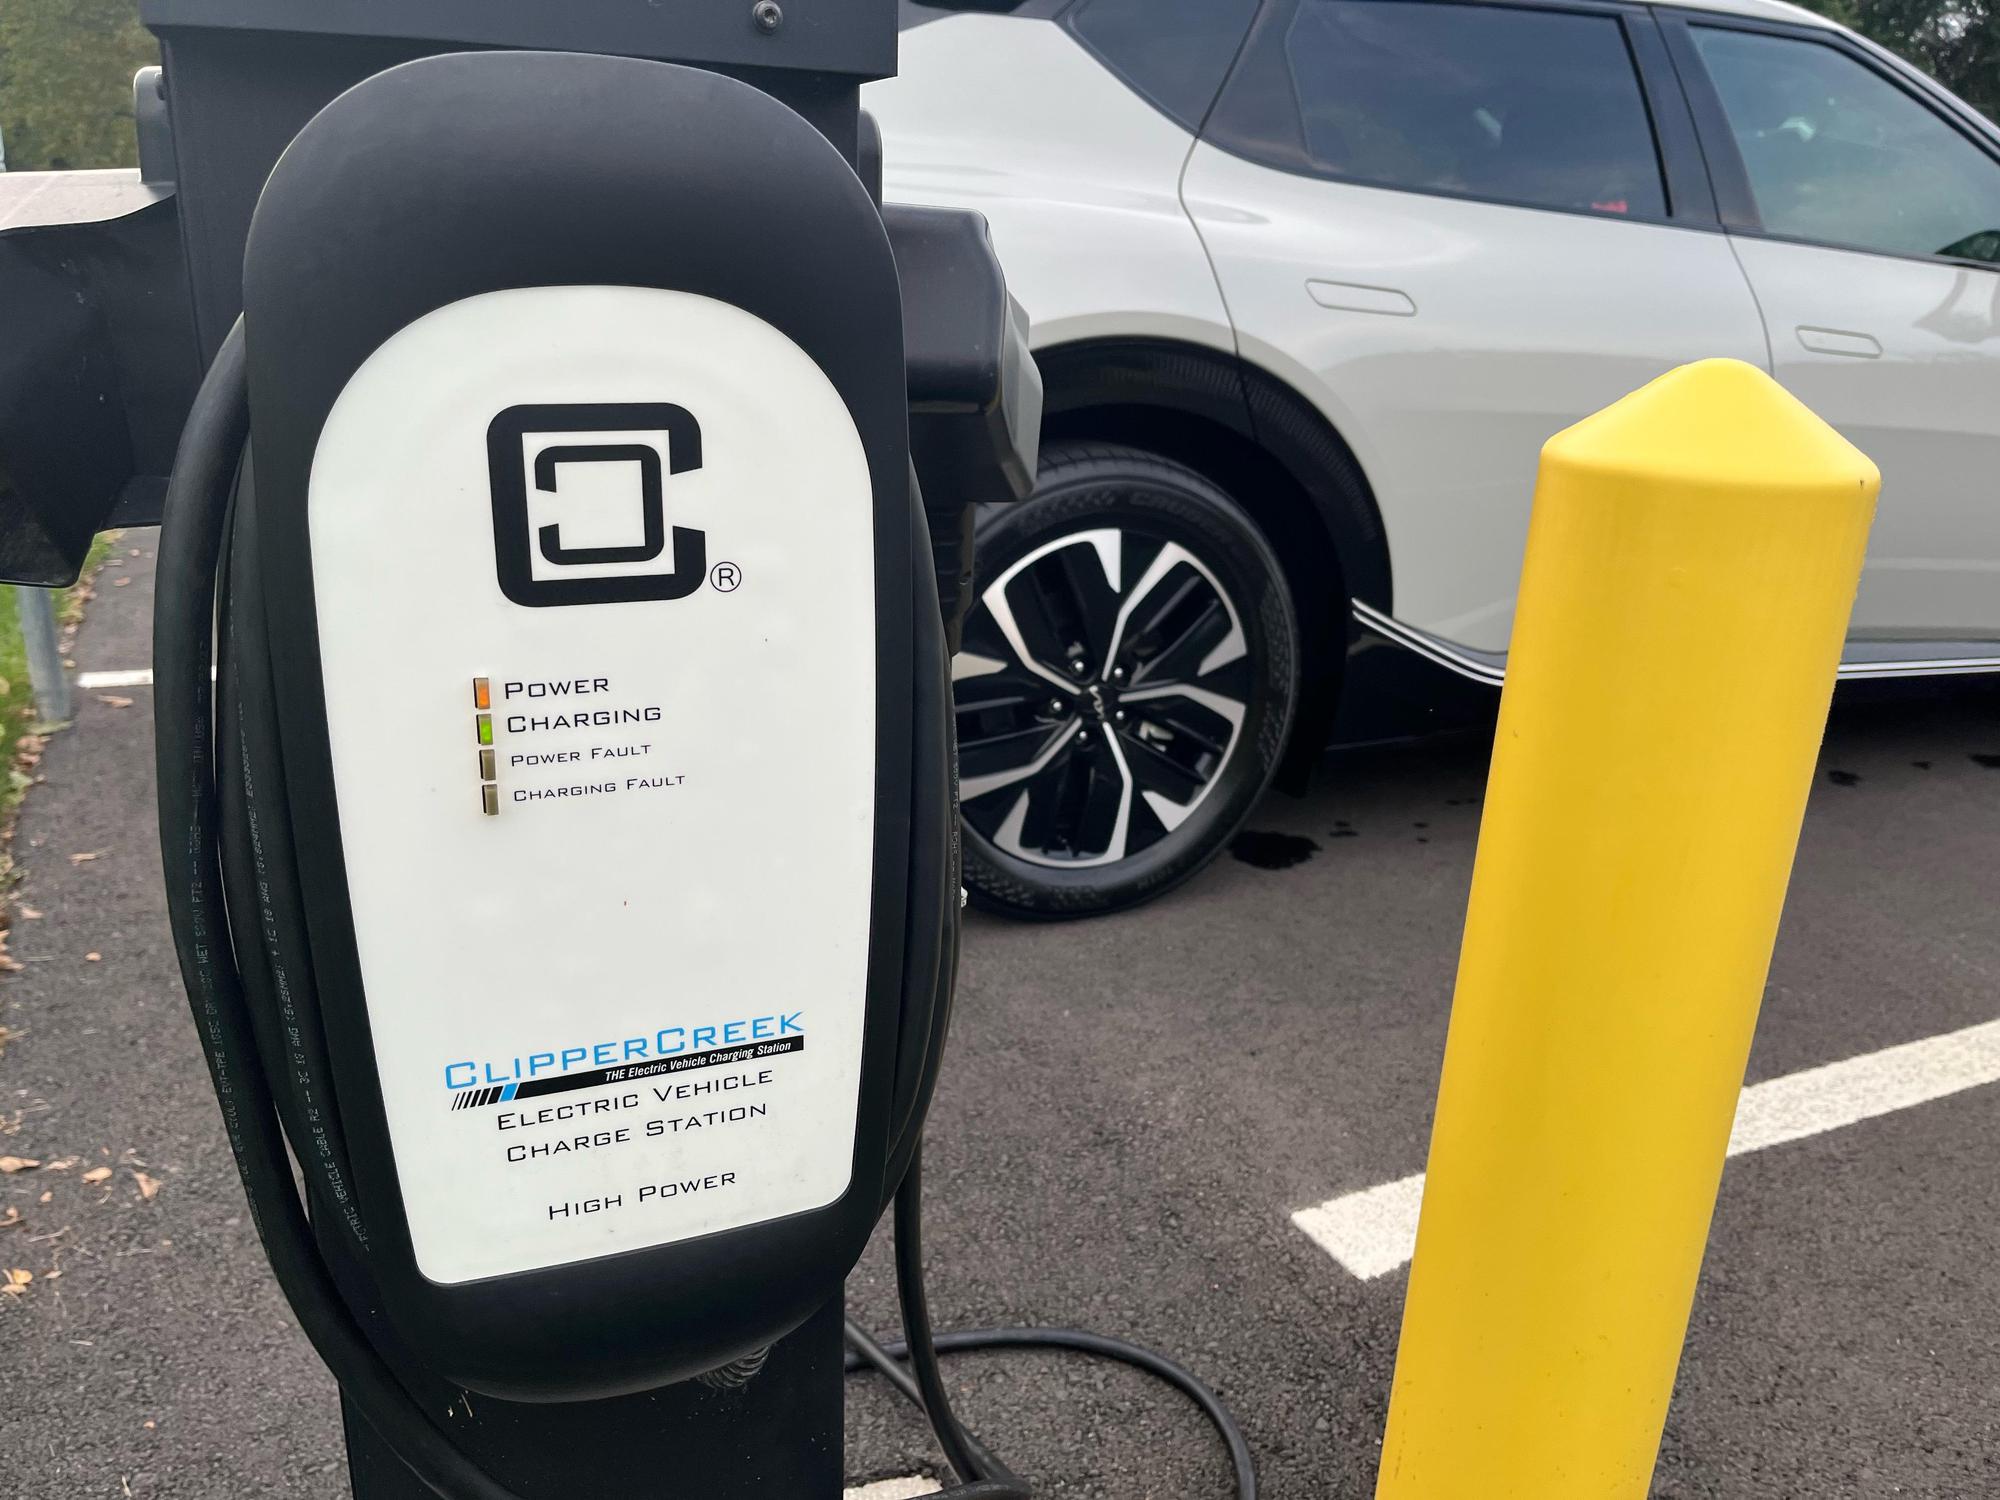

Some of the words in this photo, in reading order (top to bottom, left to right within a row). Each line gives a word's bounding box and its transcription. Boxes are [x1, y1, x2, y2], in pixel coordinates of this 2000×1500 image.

[505, 678, 610, 700] POWER
[507, 707, 662, 733] CHARGING
[511, 750, 581, 767] POWER
[591, 744, 652, 760] FAULT
[513, 782, 617, 802] CHARGING
[626, 775, 686, 790] FAULT
[195, 943, 209, 966] WET
[445, 1011, 805, 1090] CLIPPERCREEK
[605, 1071, 626, 1082] THE
[628, 1062, 667, 1078] Electric
[670, 1055, 707, 1071] Vehicle
[709, 1047, 754, 1064] Charging
[757, 1041, 792, 1055] Station
[497, 1093, 639, 1131] ELECTRIC
[653, 1070, 774, 1102] VEHICLE
[312, 1126, 332, 1158] CABLE
[507, 1128, 631, 1162] CHARGE
[646, 1103, 767, 1137] STATION
[548, 1194, 622, 1220] HIGH
[639, 1172, 737, 1202] POWER
